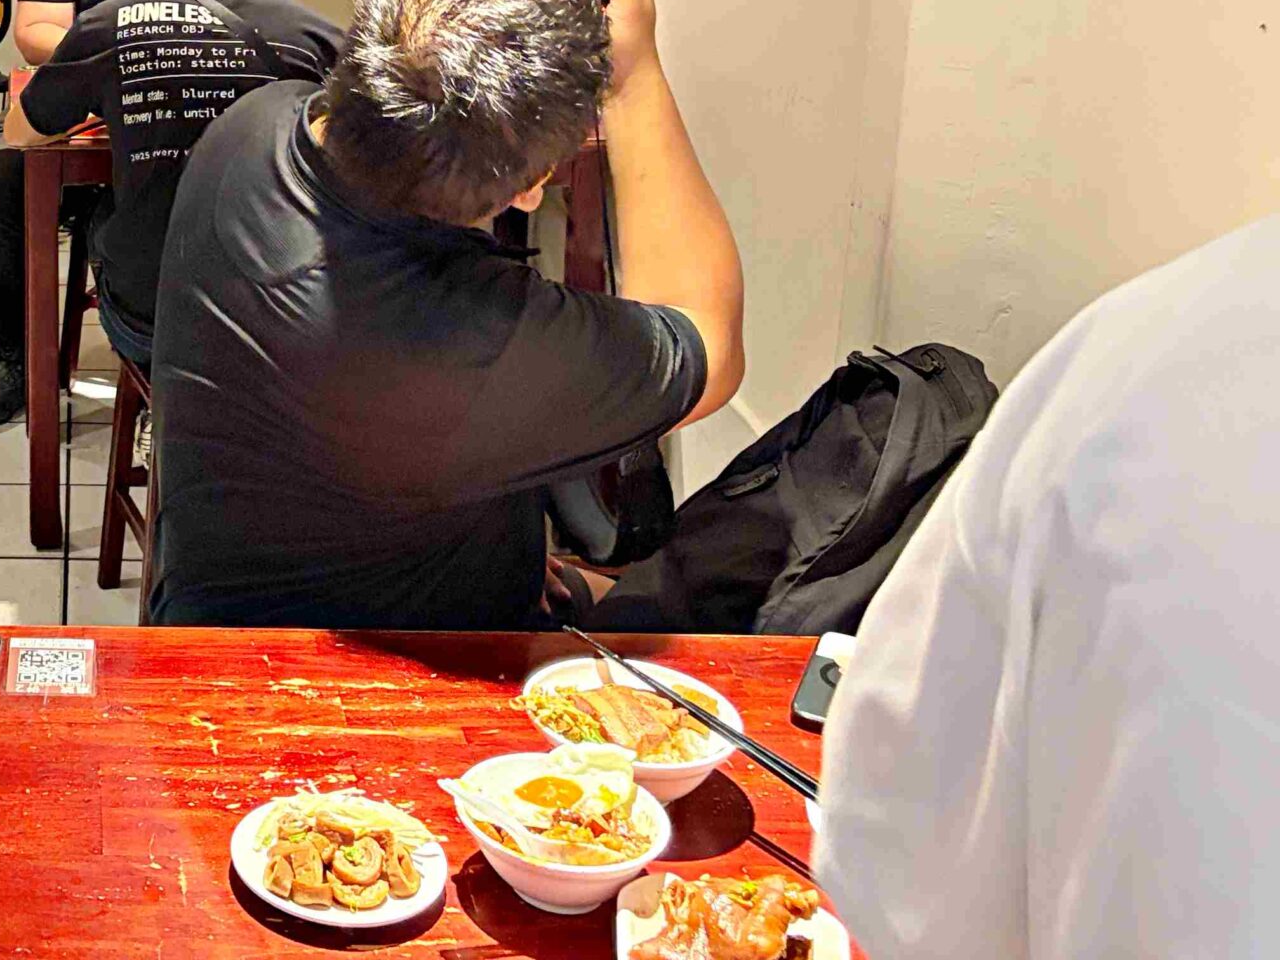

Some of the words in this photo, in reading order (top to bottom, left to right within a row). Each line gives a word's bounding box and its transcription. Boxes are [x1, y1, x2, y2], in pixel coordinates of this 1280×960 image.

[117, 1, 224, 27] BONELES
[116, 25, 174, 40] RESEARCH
[119, 50, 151, 63] time:
[156, 46, 203, 58] Monday
[210, 46, 227, 57] to
[120, 58, 182, 76] location:
[182, 88, 236, 99] blurred
[183, 108, 218, 119] until
